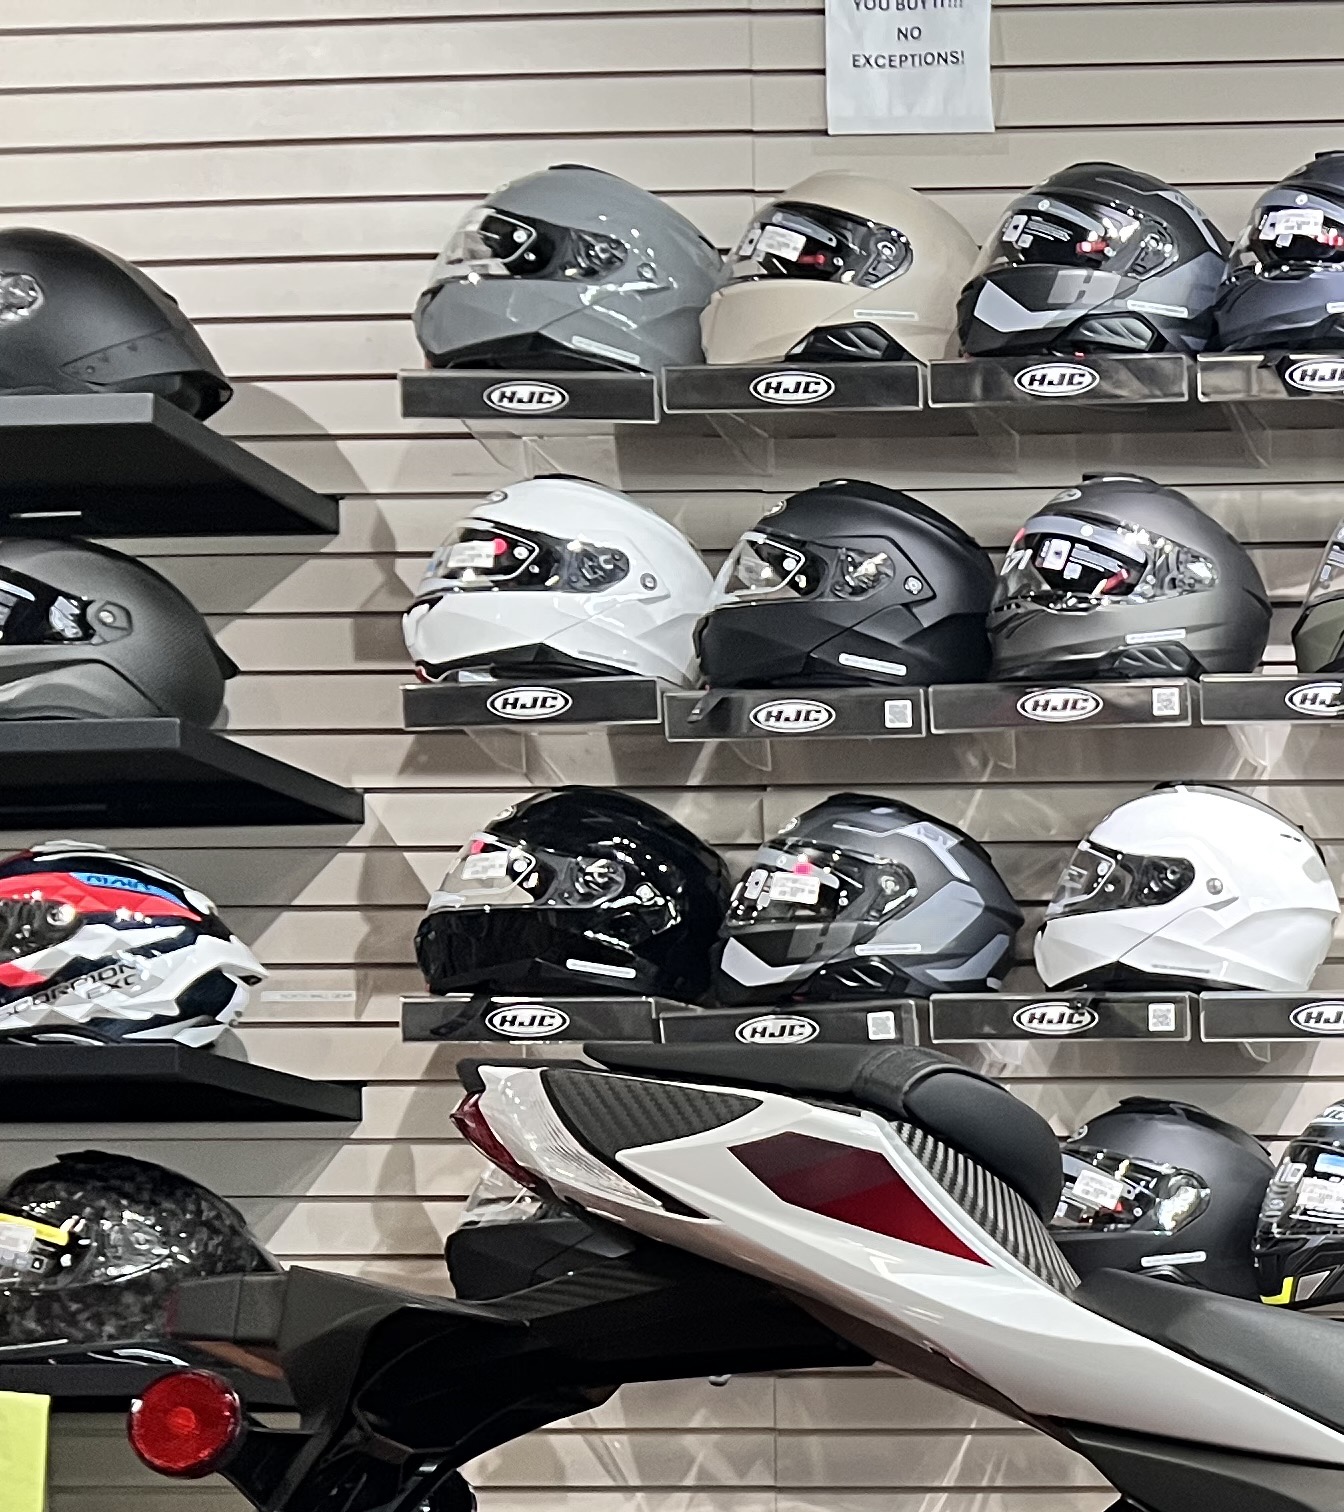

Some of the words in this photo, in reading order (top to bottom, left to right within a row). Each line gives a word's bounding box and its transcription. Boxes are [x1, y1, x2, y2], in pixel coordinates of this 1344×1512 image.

[897, 26, 922, 41] NO
[852, 50, 965, 69] EXCEPTIONS!
[763, 378, 822, 396] HJC
[1027, 369, 1087, 387] HJC
[496, 387, 557, 408] HJC
[500, 694, 560, 712] HJC
[1032, 696, 1090, 714] HJC
[763, 707, 824, 725] HJC
[499, 1012, 559, 1030] HJC
[1027, 1009, 1087, 1026] HJC
[748, 1022, 809, 1040] HJC
